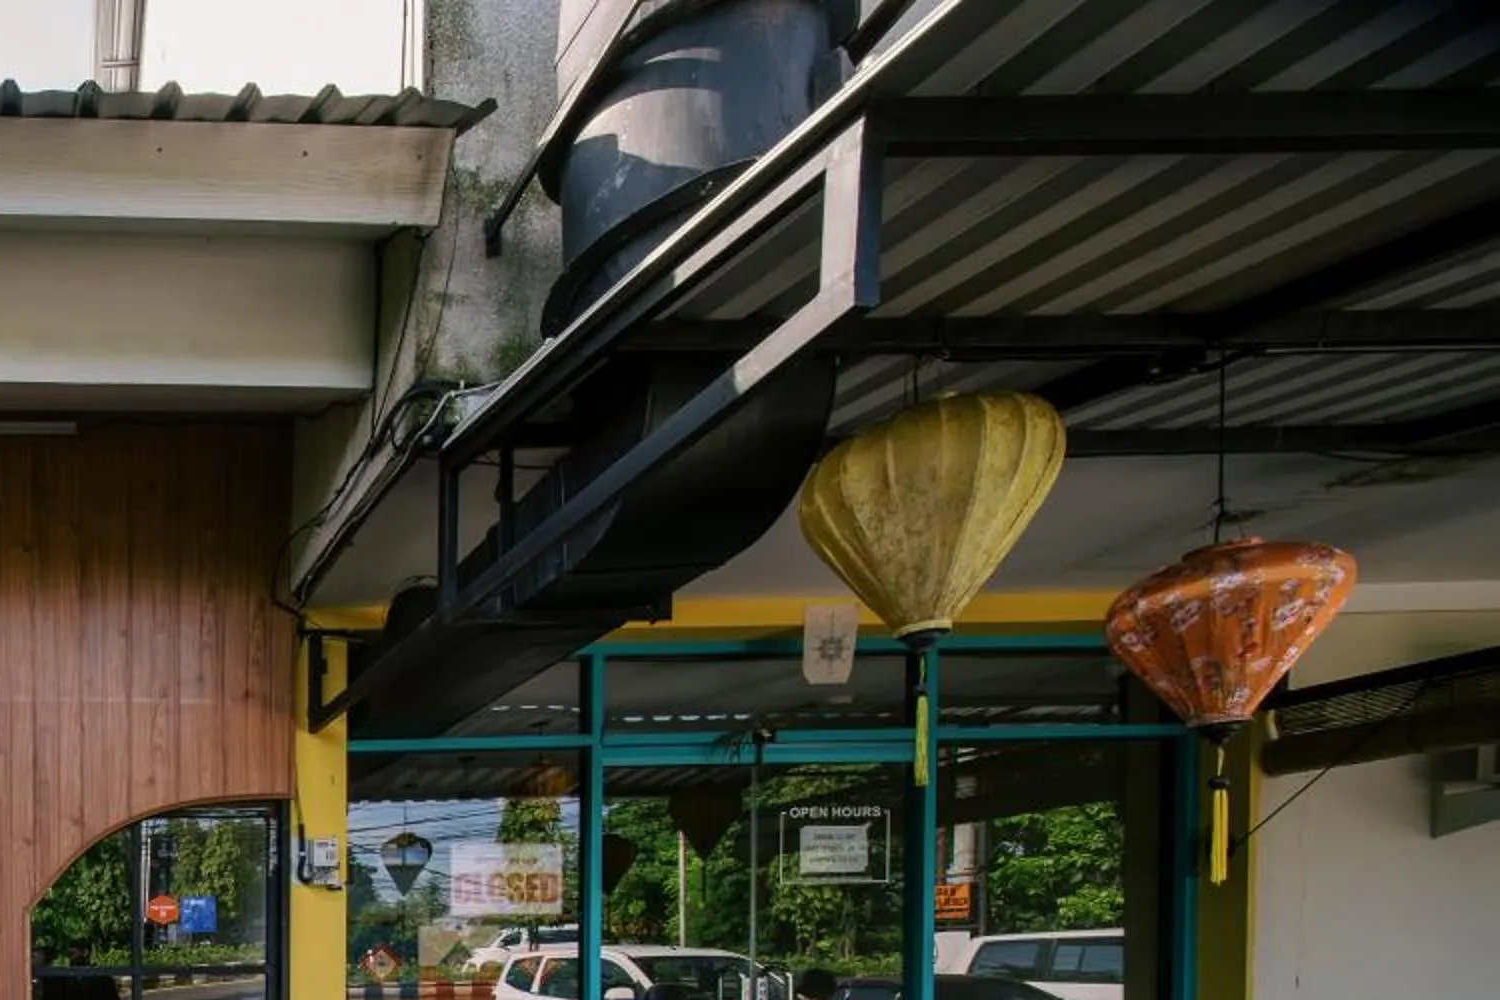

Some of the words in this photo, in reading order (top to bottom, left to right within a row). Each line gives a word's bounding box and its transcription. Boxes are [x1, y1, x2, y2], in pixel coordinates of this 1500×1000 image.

[789, 806, 828, 818] OPEN
[831, 805, 881, 817] HOURS
[454, 872, 559, 904] CLOSED
